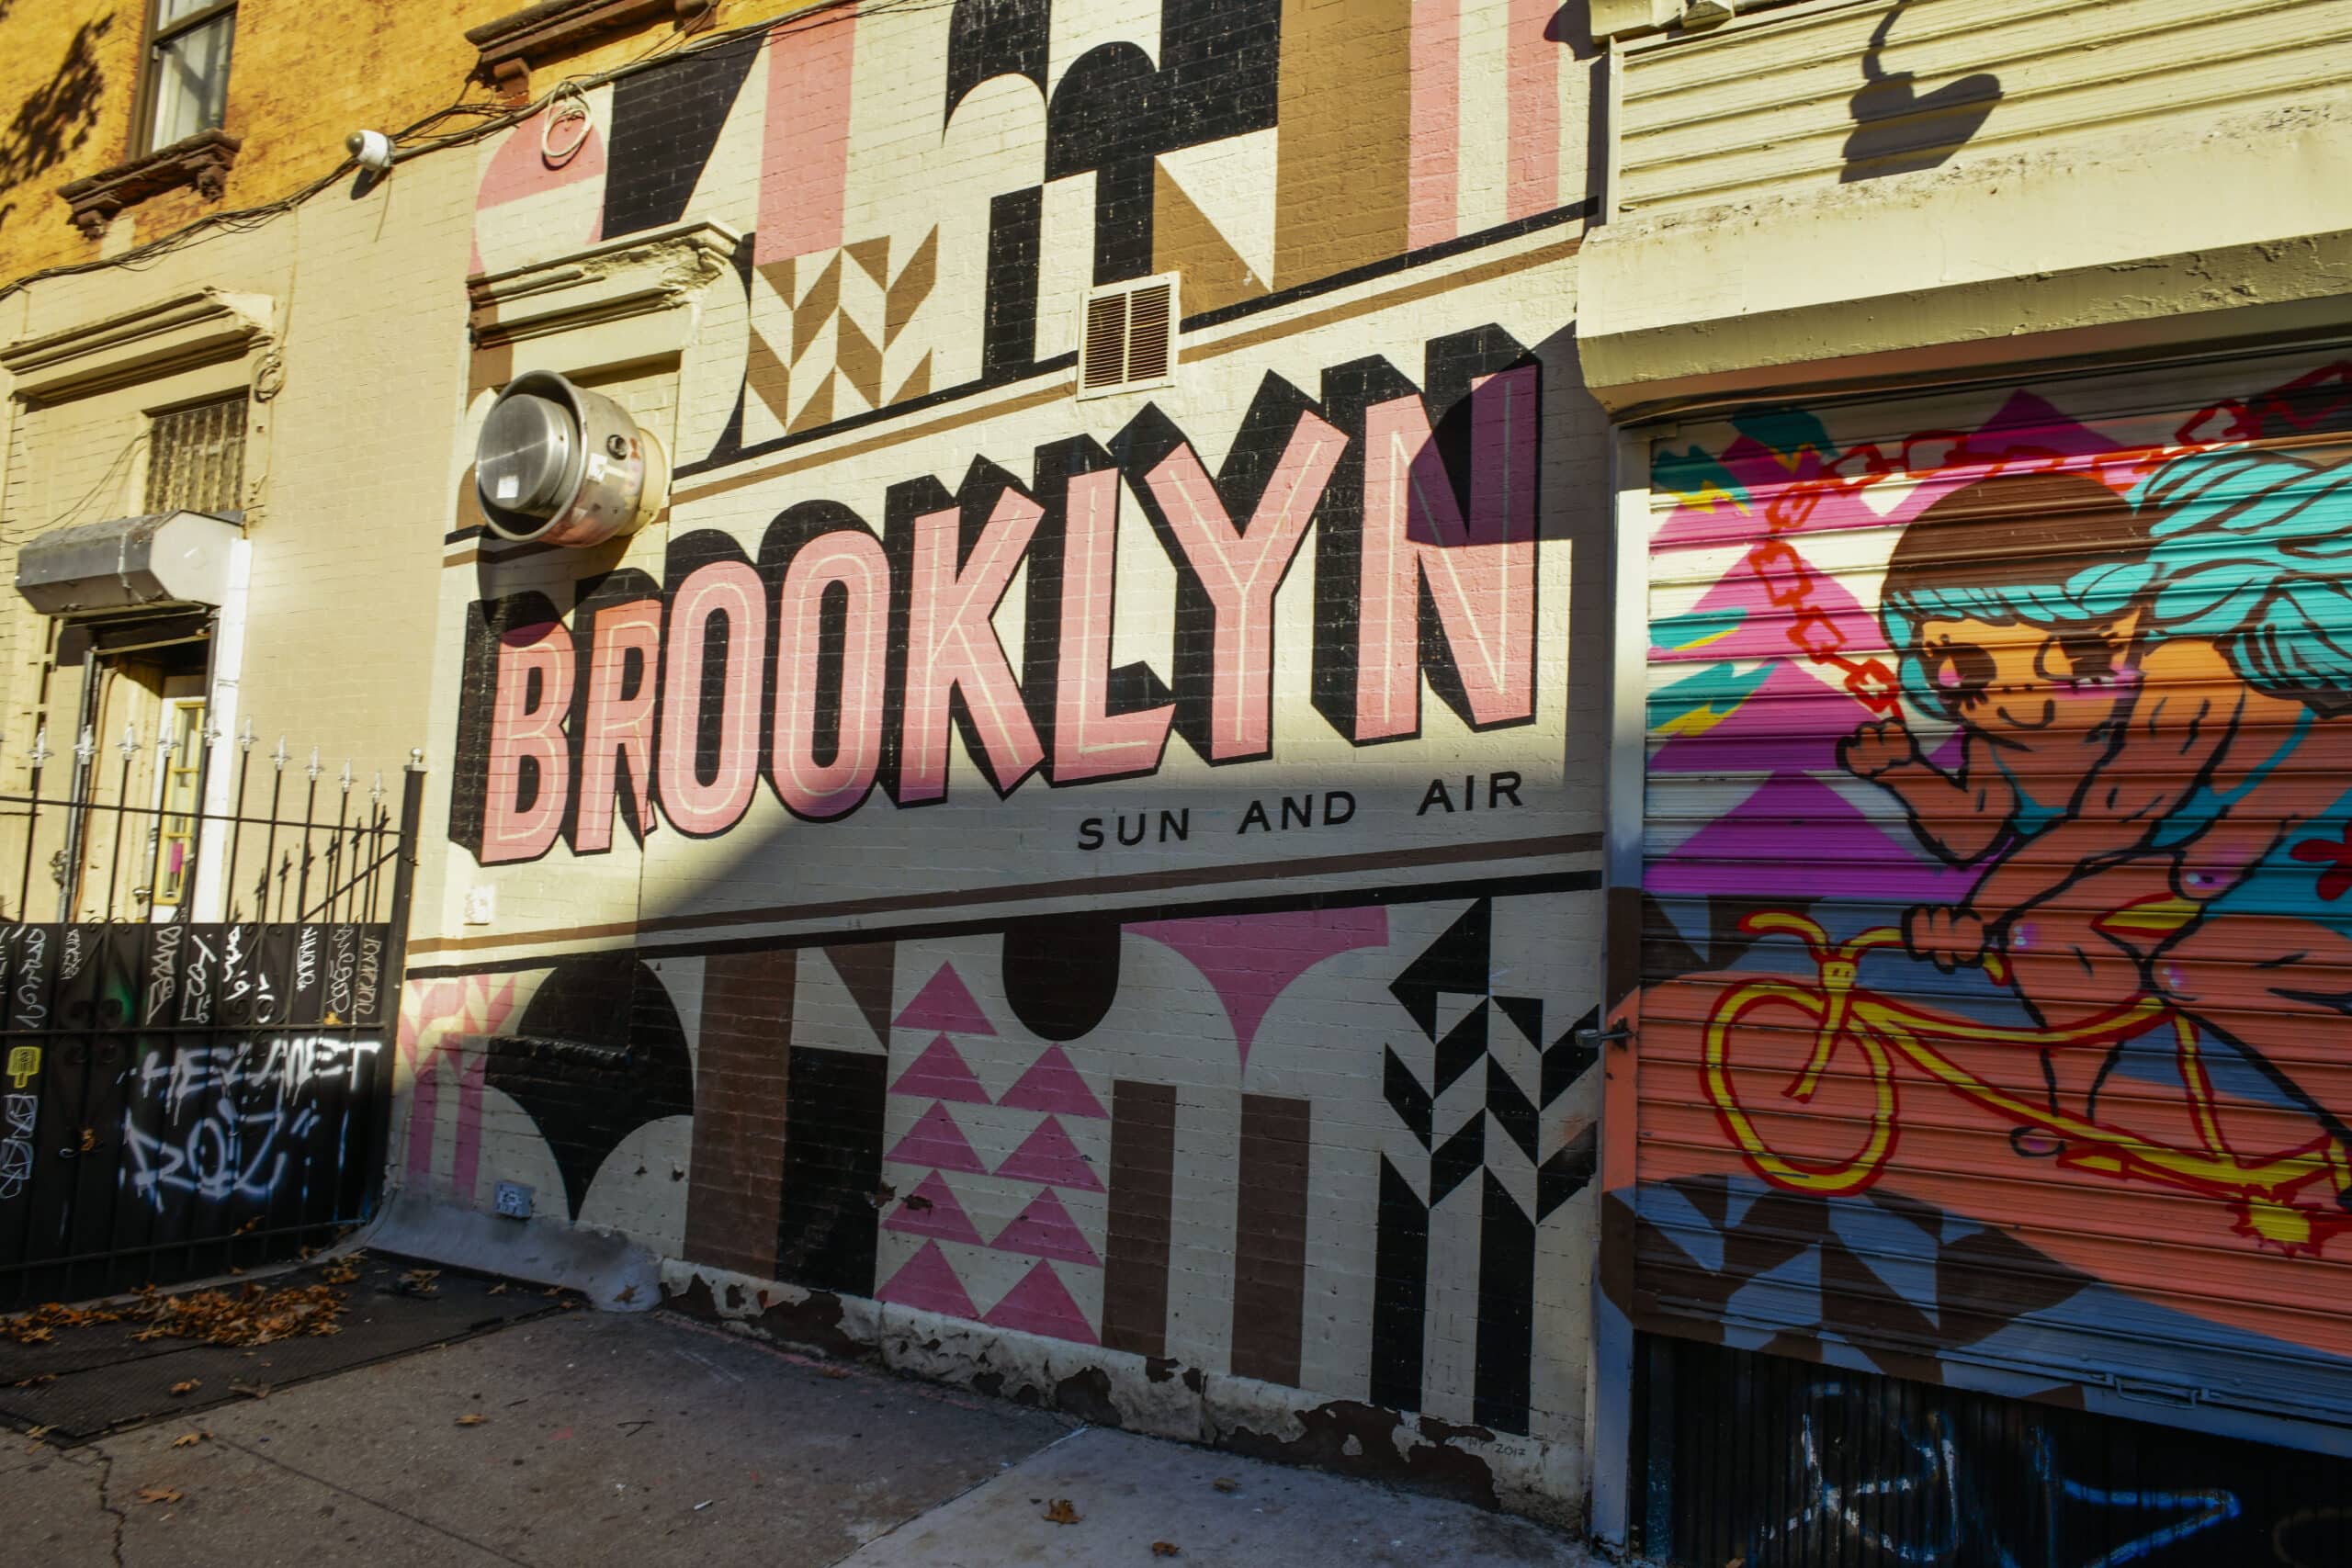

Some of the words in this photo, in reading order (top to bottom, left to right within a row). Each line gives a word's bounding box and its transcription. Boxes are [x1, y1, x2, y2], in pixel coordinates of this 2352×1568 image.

[449, 323, 1542, 865] BROOKLYN
[1078, 807, 1190, 851] SUN
[1237, 790, 1356, 834] AND
[1416, 771, 1523, 816] AIR
